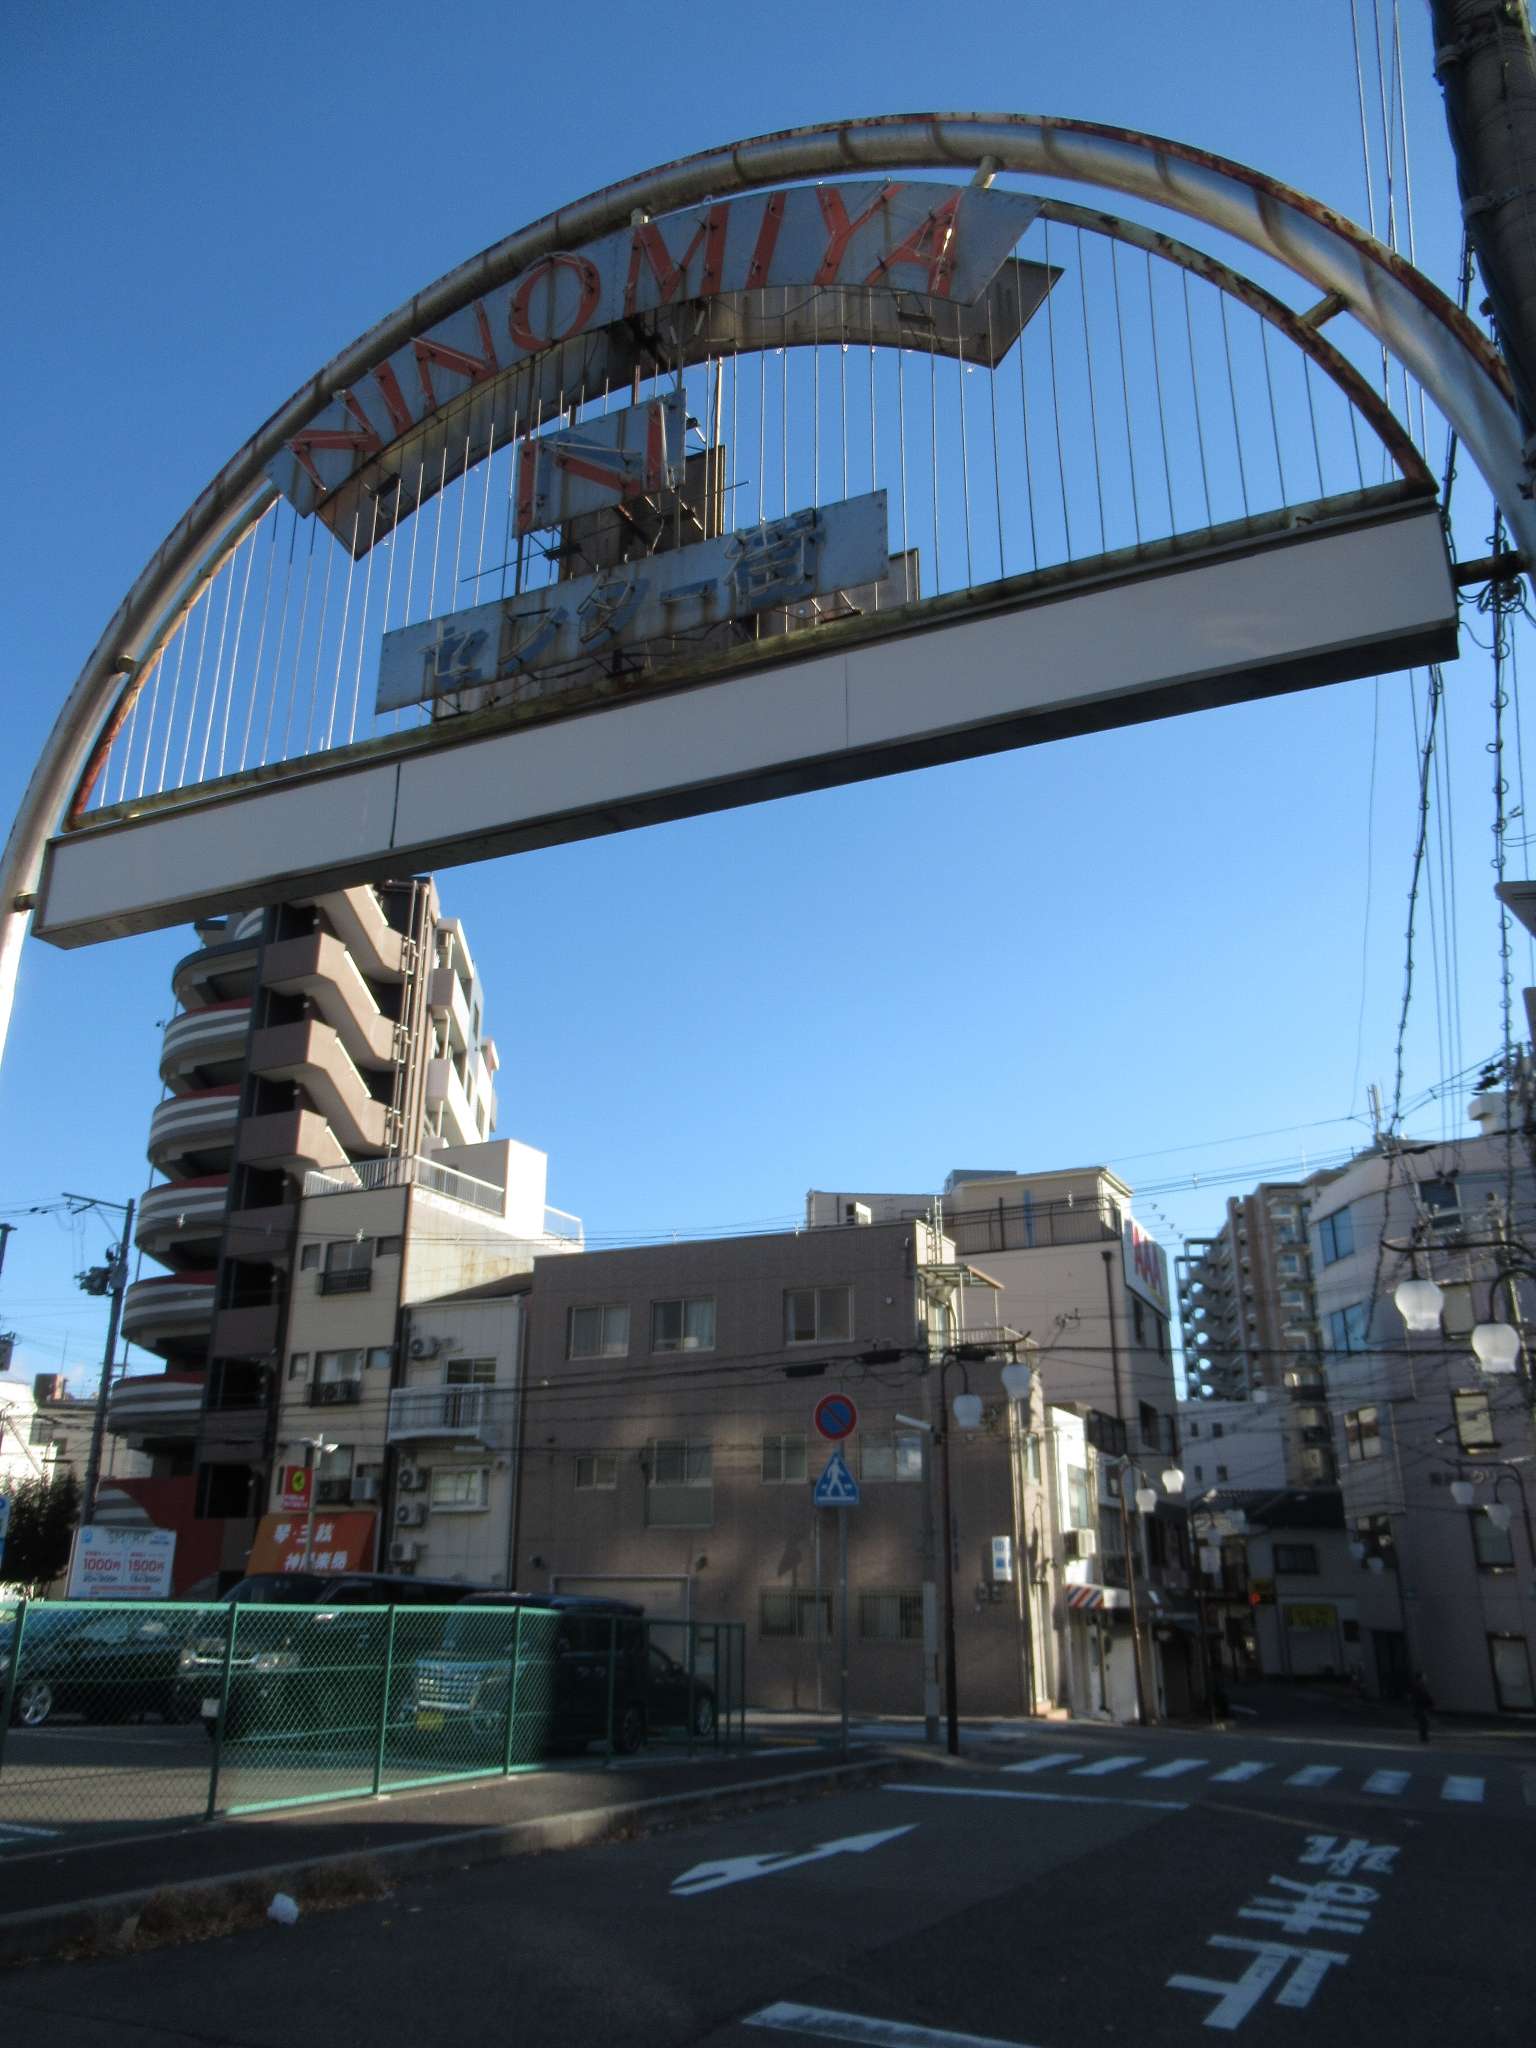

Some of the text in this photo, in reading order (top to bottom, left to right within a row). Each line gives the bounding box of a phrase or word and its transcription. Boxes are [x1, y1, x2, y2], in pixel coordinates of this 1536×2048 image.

[288, 182, 963, 495] NINOMIYA
[418, 508, 826, 690] センター街
